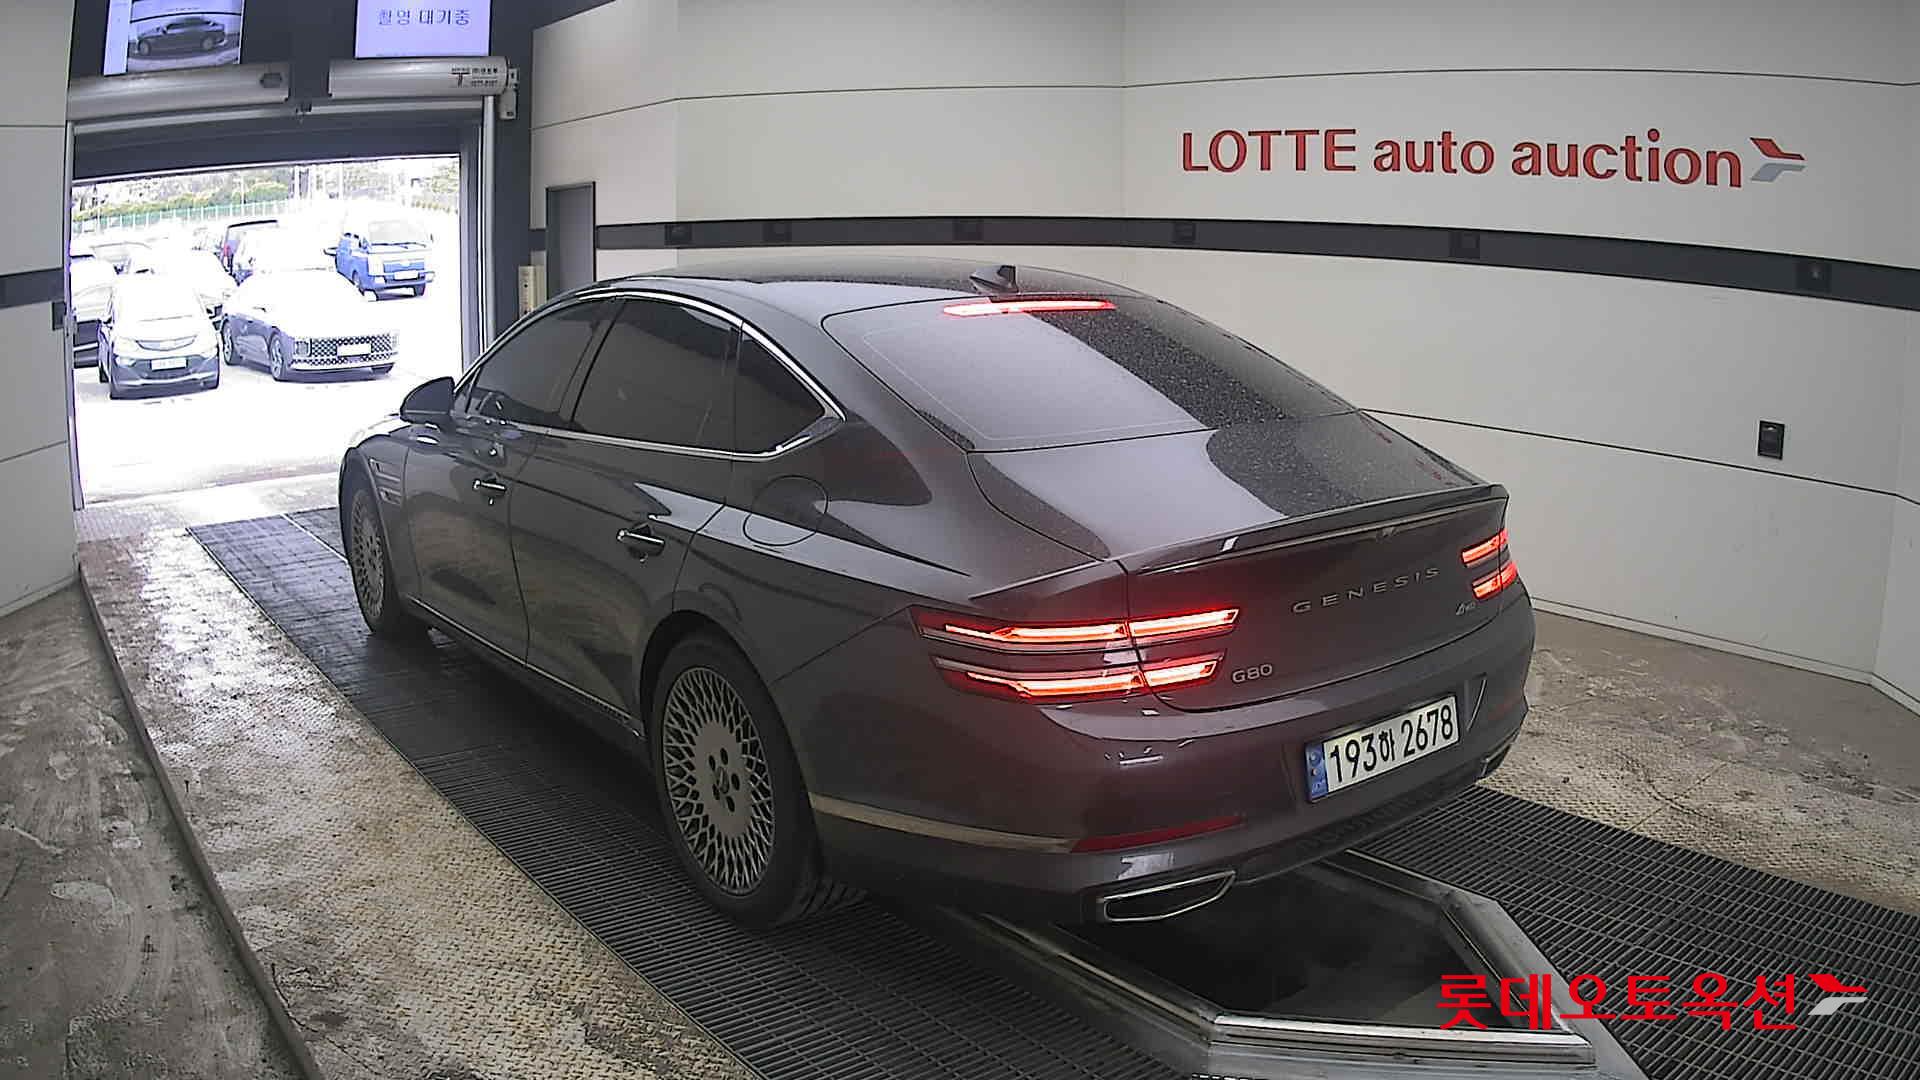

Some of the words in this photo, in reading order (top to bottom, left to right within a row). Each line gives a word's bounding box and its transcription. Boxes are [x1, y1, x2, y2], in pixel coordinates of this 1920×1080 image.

[419, 9, 470, 26] 대기중
[1183, 129, 1357, 171] LOTTE
[1373, 130, 1494, 174] auto
[1512, 129, 1741, 187] auction
[1292, 567, 1440, 614] GENESIS
[1231, 663, 1274, 684] G80
[1330, 728, 1396, 783] 193하
[1400, 704, 1454, 758] 2678
